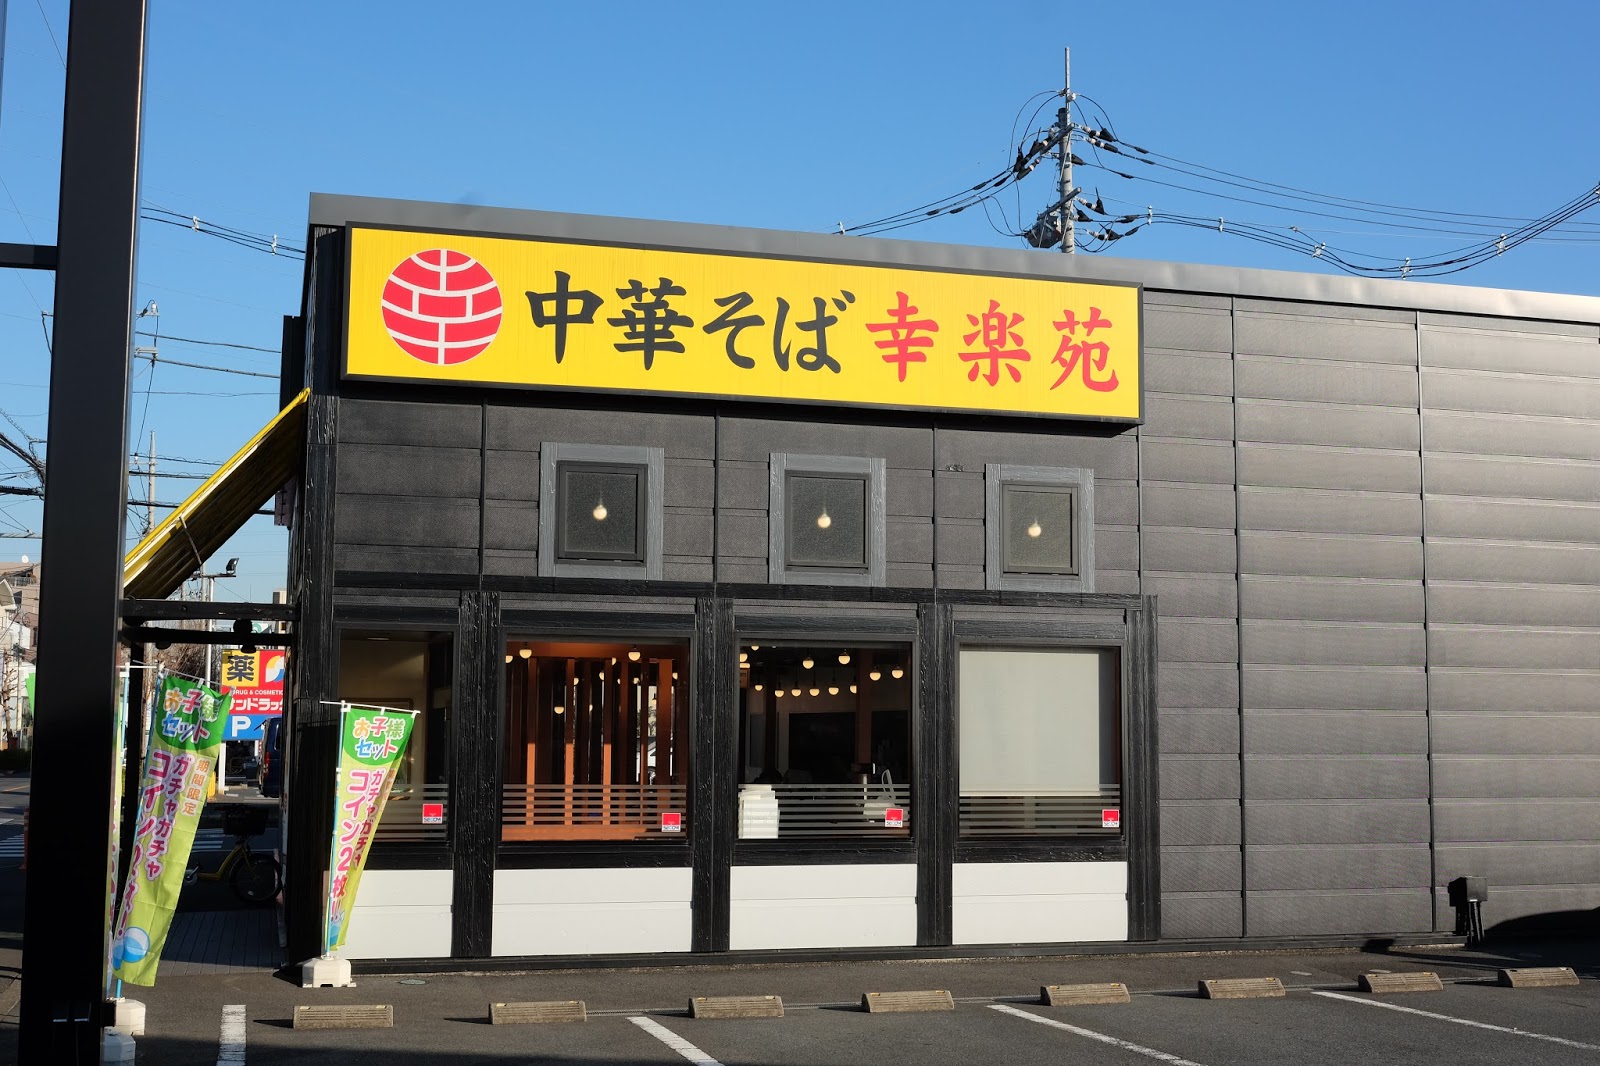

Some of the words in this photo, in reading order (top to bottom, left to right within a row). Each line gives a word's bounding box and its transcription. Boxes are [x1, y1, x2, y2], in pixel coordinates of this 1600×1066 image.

[525, 270, 854, 373] 中華そば
[866, 291, 1120, 392] 幸楽苑
[227, 654, 254, 682] 薬
[162, 711, 210, 743] セット
[231, 716, 251, 737] P
[353, 717, 405, 739] お子様
[356, 739, 398, 760] セット
[182, 758, 211, 816] 期間限定
[146, 755, 194, 880] ガチャガチャ
